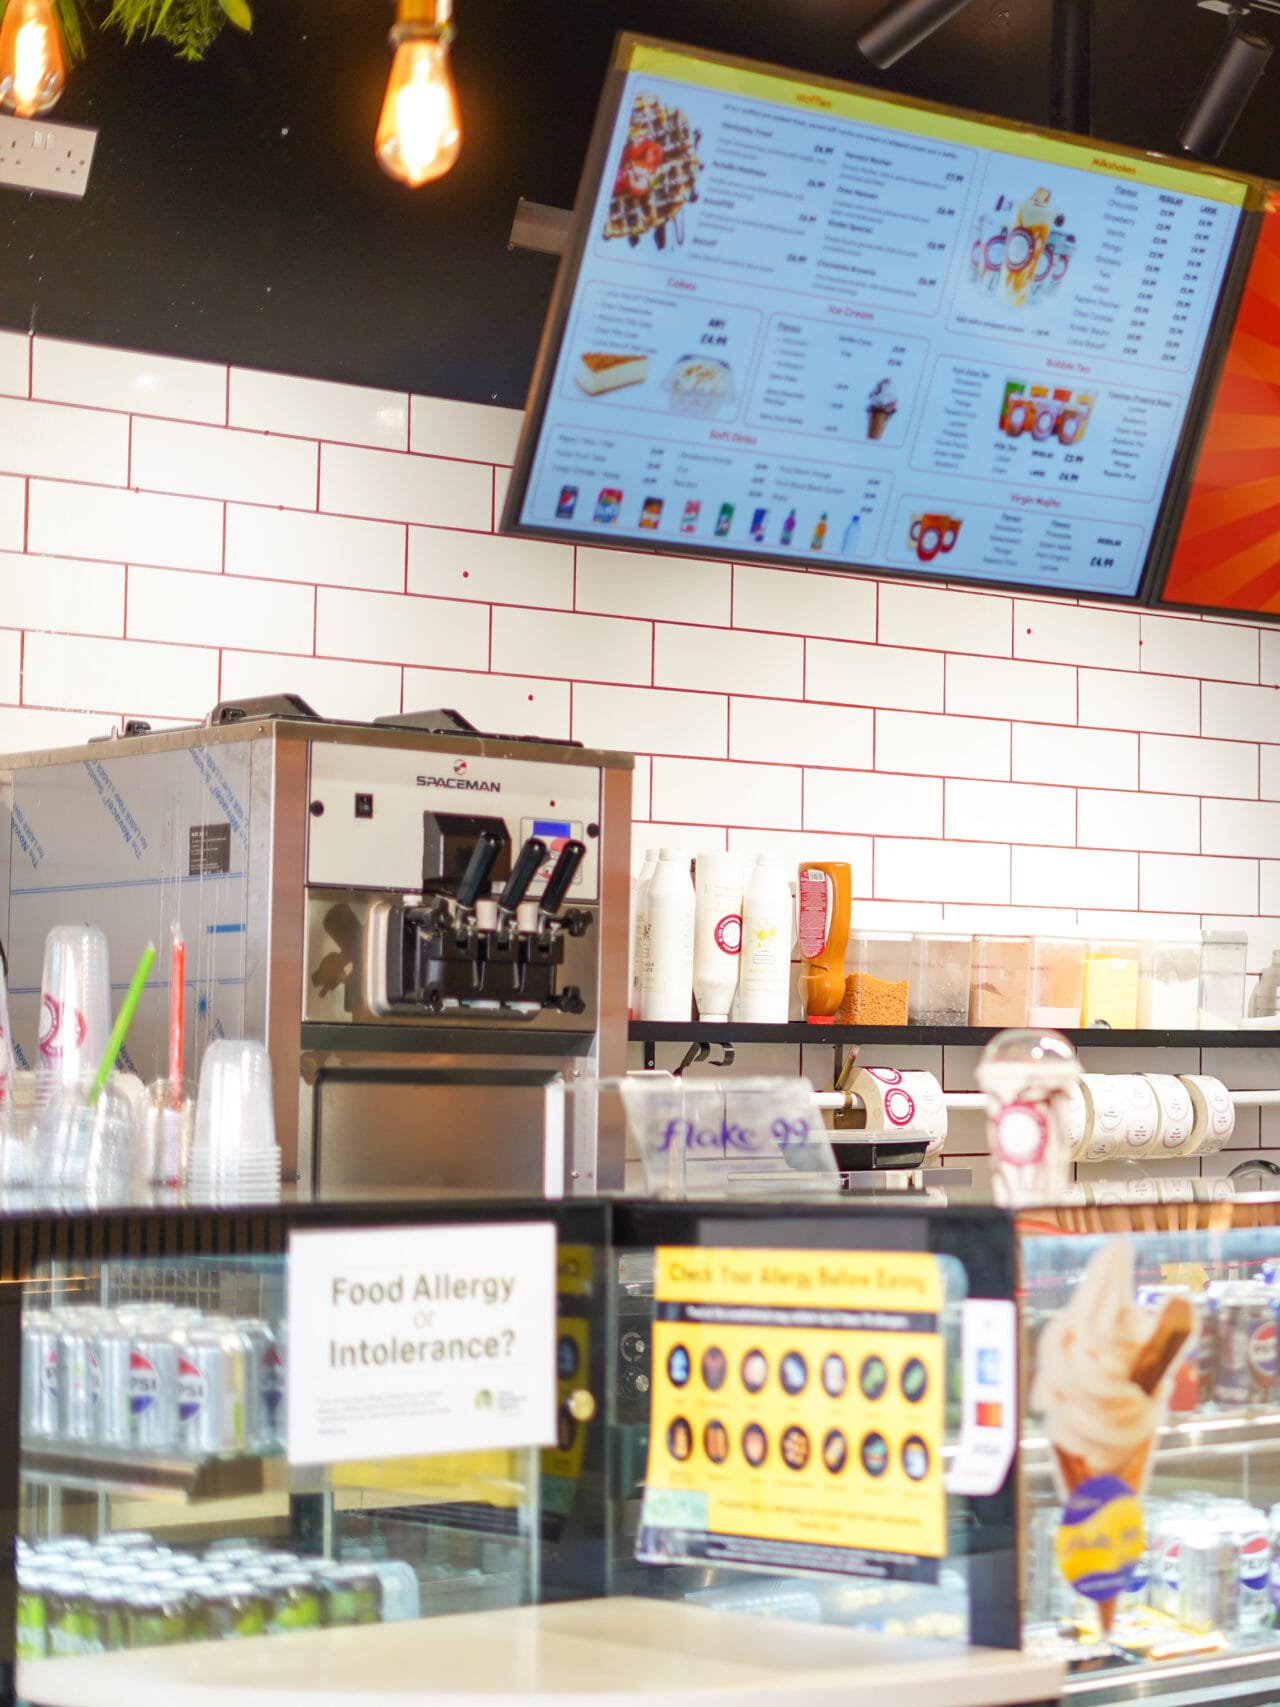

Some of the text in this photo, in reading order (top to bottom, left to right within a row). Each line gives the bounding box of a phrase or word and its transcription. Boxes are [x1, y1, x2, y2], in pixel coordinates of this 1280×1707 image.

[416, 775, 501, 793] SPACEMAN
[770, 1117, 810, 1150] 99
[331, 1272, 516, 1306] Food Allergy
[668, 1262, 929, 1294] Check Your Allergy Before Eating
[329, 1328, 517, 1368] Intolerance?
